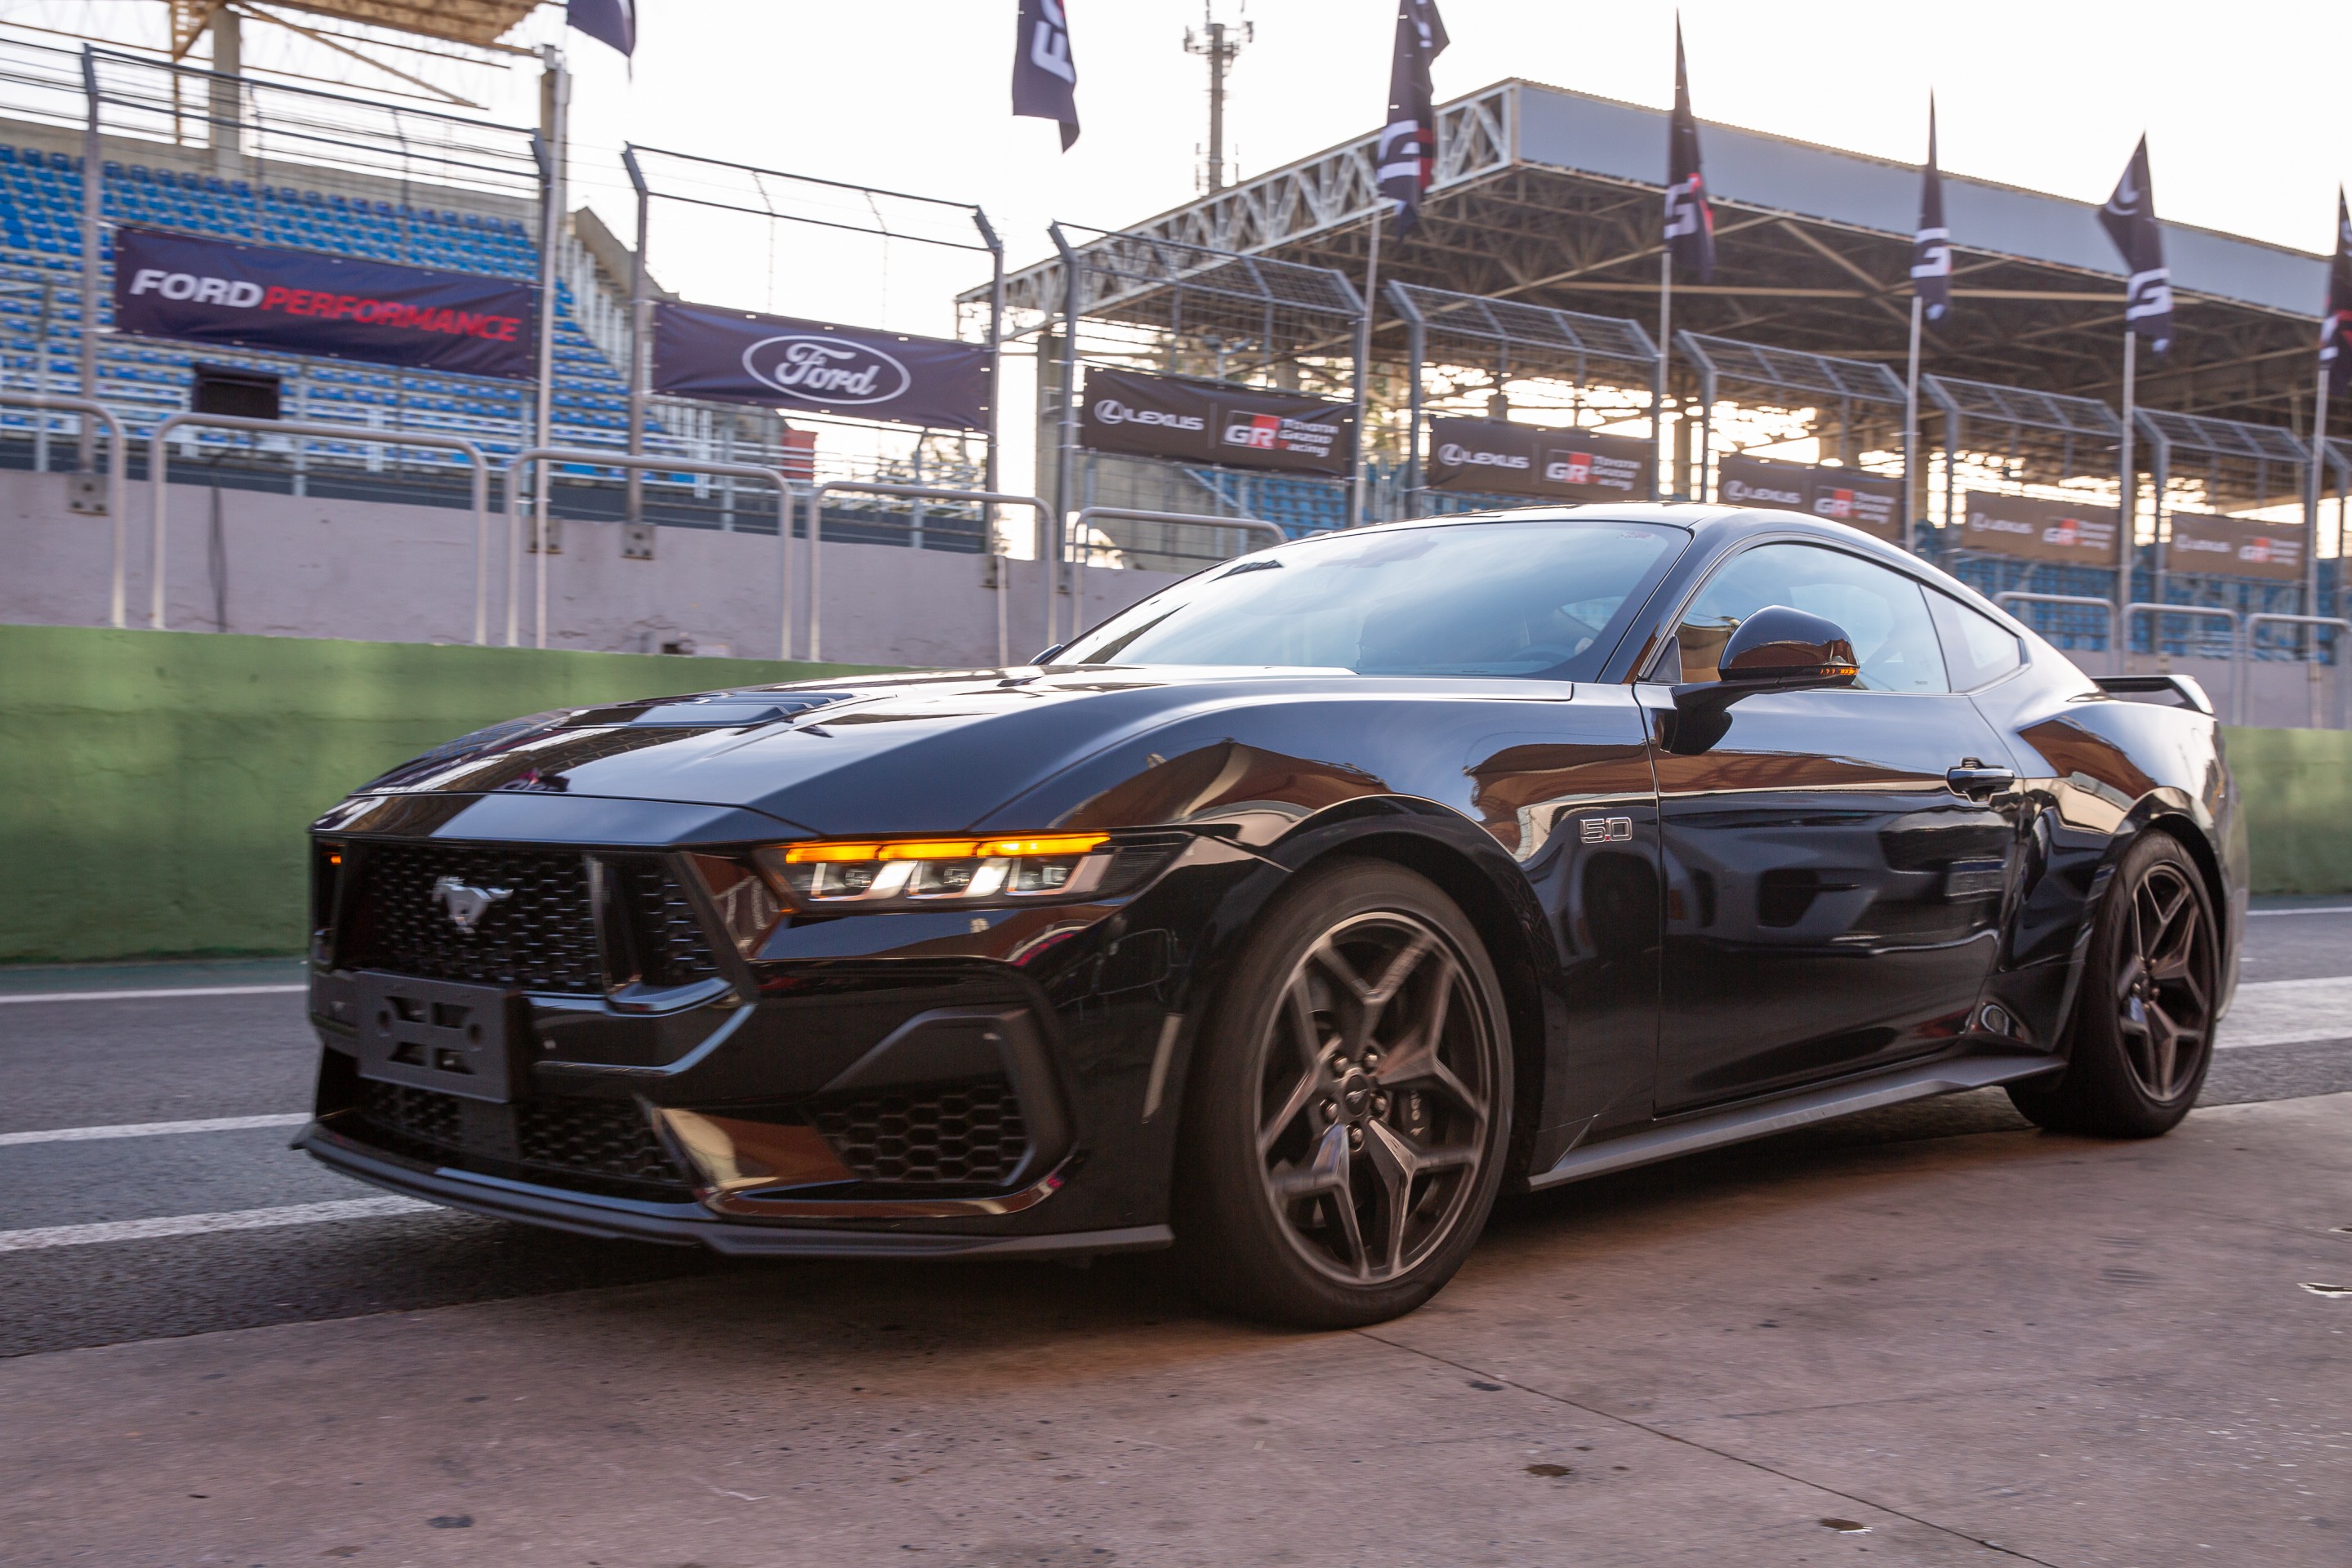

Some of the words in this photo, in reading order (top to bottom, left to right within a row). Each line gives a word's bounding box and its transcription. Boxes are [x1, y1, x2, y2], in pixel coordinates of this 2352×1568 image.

[129, 269, 264, 309] FORD
[261, 286, 522, 342] PERFORMANCE
[775, 342, 880, 395] Ford
[1123, 408, 1205, 431] LEXUS
[1225, 424, 1276, 448] GR
[1463, 452, 1530, 469] LEXUS
[1546, 462, 1588, 483] GR
[1579, 817, 1633, 844] 5.0
